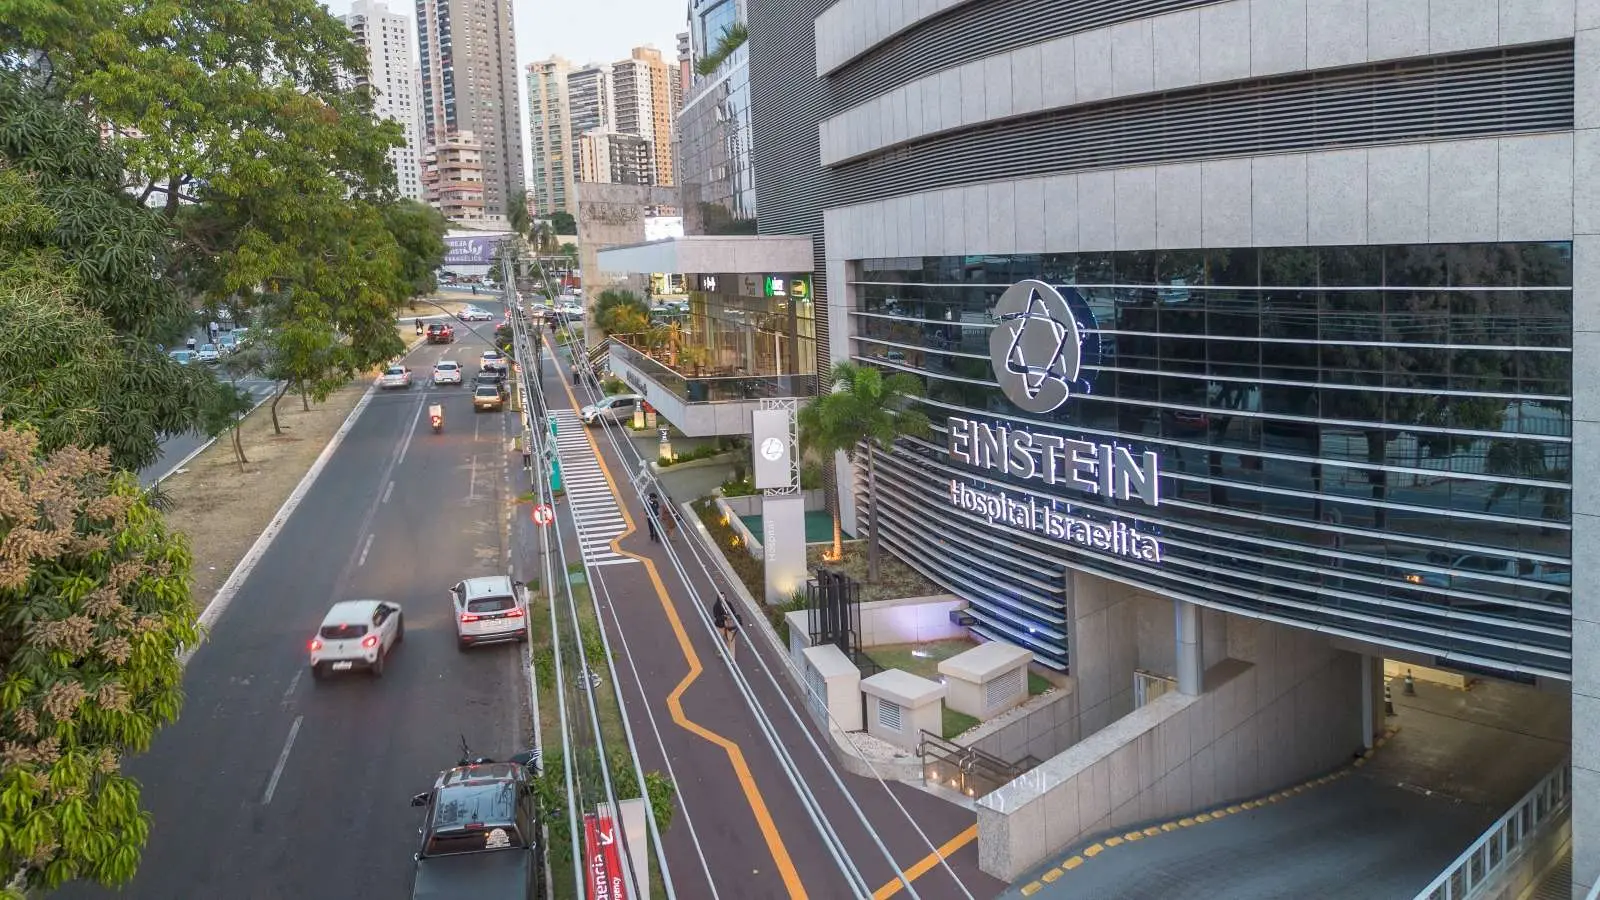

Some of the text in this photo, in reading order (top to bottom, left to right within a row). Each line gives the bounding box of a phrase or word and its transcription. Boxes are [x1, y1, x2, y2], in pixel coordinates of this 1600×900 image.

[949, 416, 1159, 506] EINSTEIN
[951, 479, 1161, 562] Hospital Israelita
